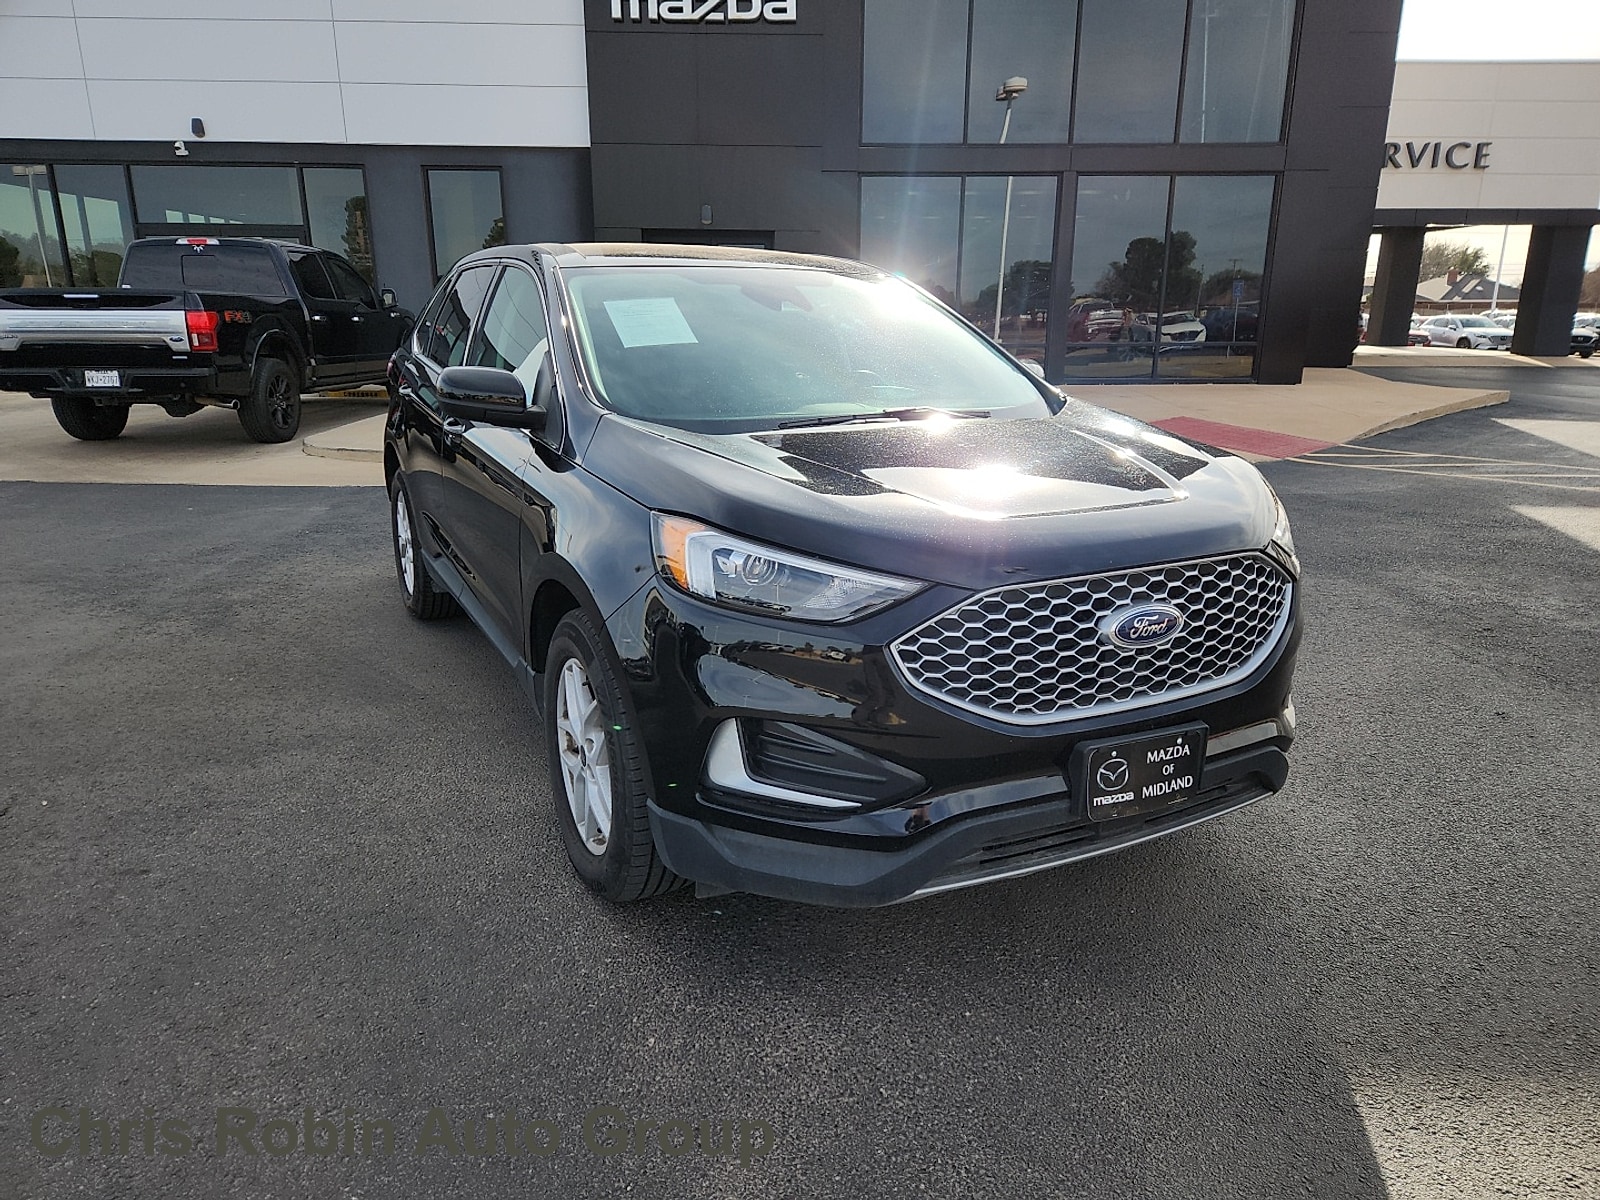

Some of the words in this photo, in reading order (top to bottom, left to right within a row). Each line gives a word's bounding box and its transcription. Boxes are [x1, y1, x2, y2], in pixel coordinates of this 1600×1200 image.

[1383, 141, 1493, 170] RVICE
[1129, 614, 1170, 639] Ford
[1146, 744, 1191, 764] MAZDA
[1162, 763, 1176, 776] OF
[1141, 775, 1194, 799] MIDLAND
[1093, 791, 1135, 807] mazda
